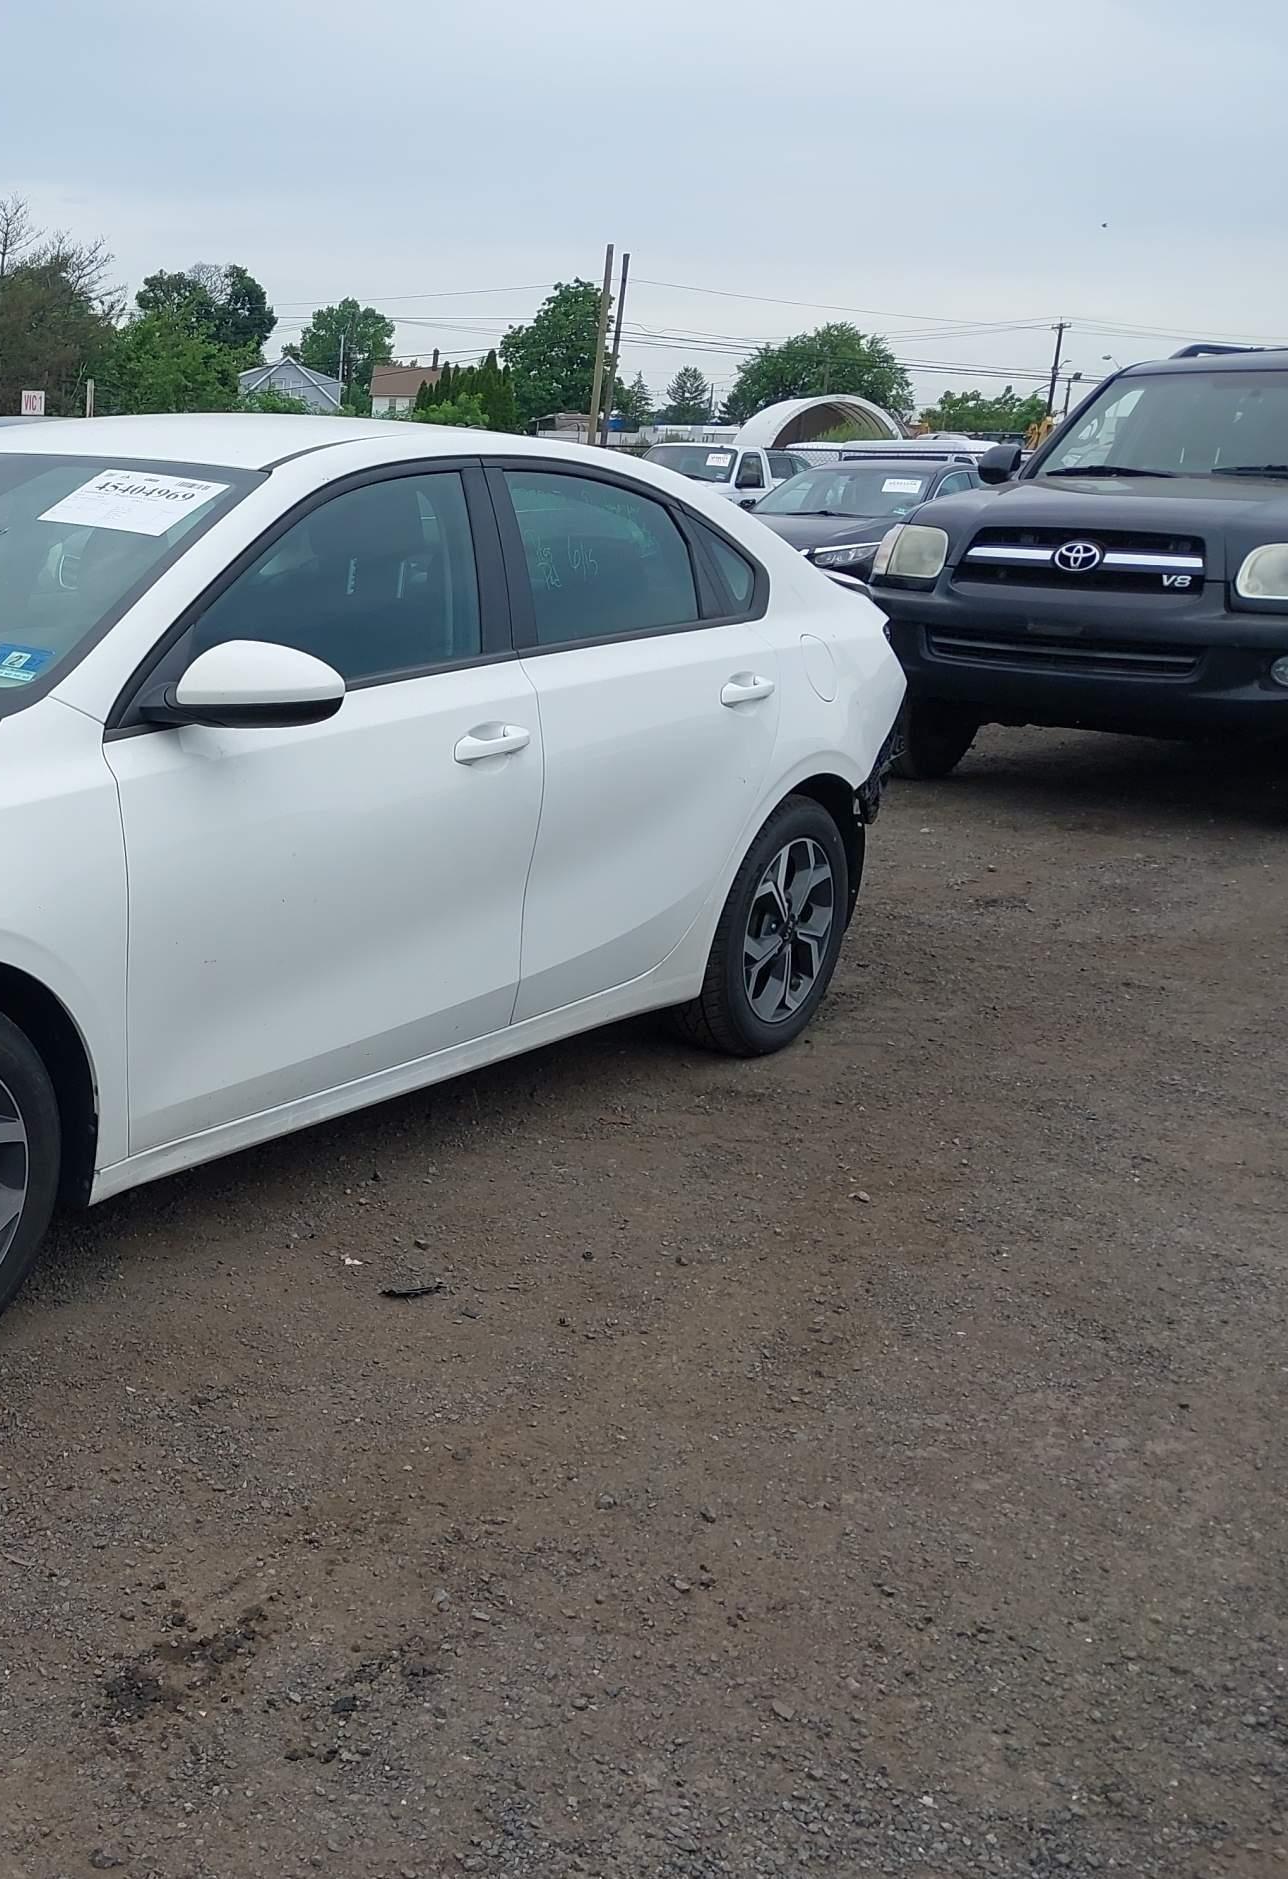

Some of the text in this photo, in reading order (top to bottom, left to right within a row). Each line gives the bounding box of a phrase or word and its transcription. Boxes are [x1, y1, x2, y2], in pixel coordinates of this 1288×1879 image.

[24, 394, 37, 411] VIC
[95, 481, 196, 502] 45404969
[1161, 574, 1192, 588] V8
